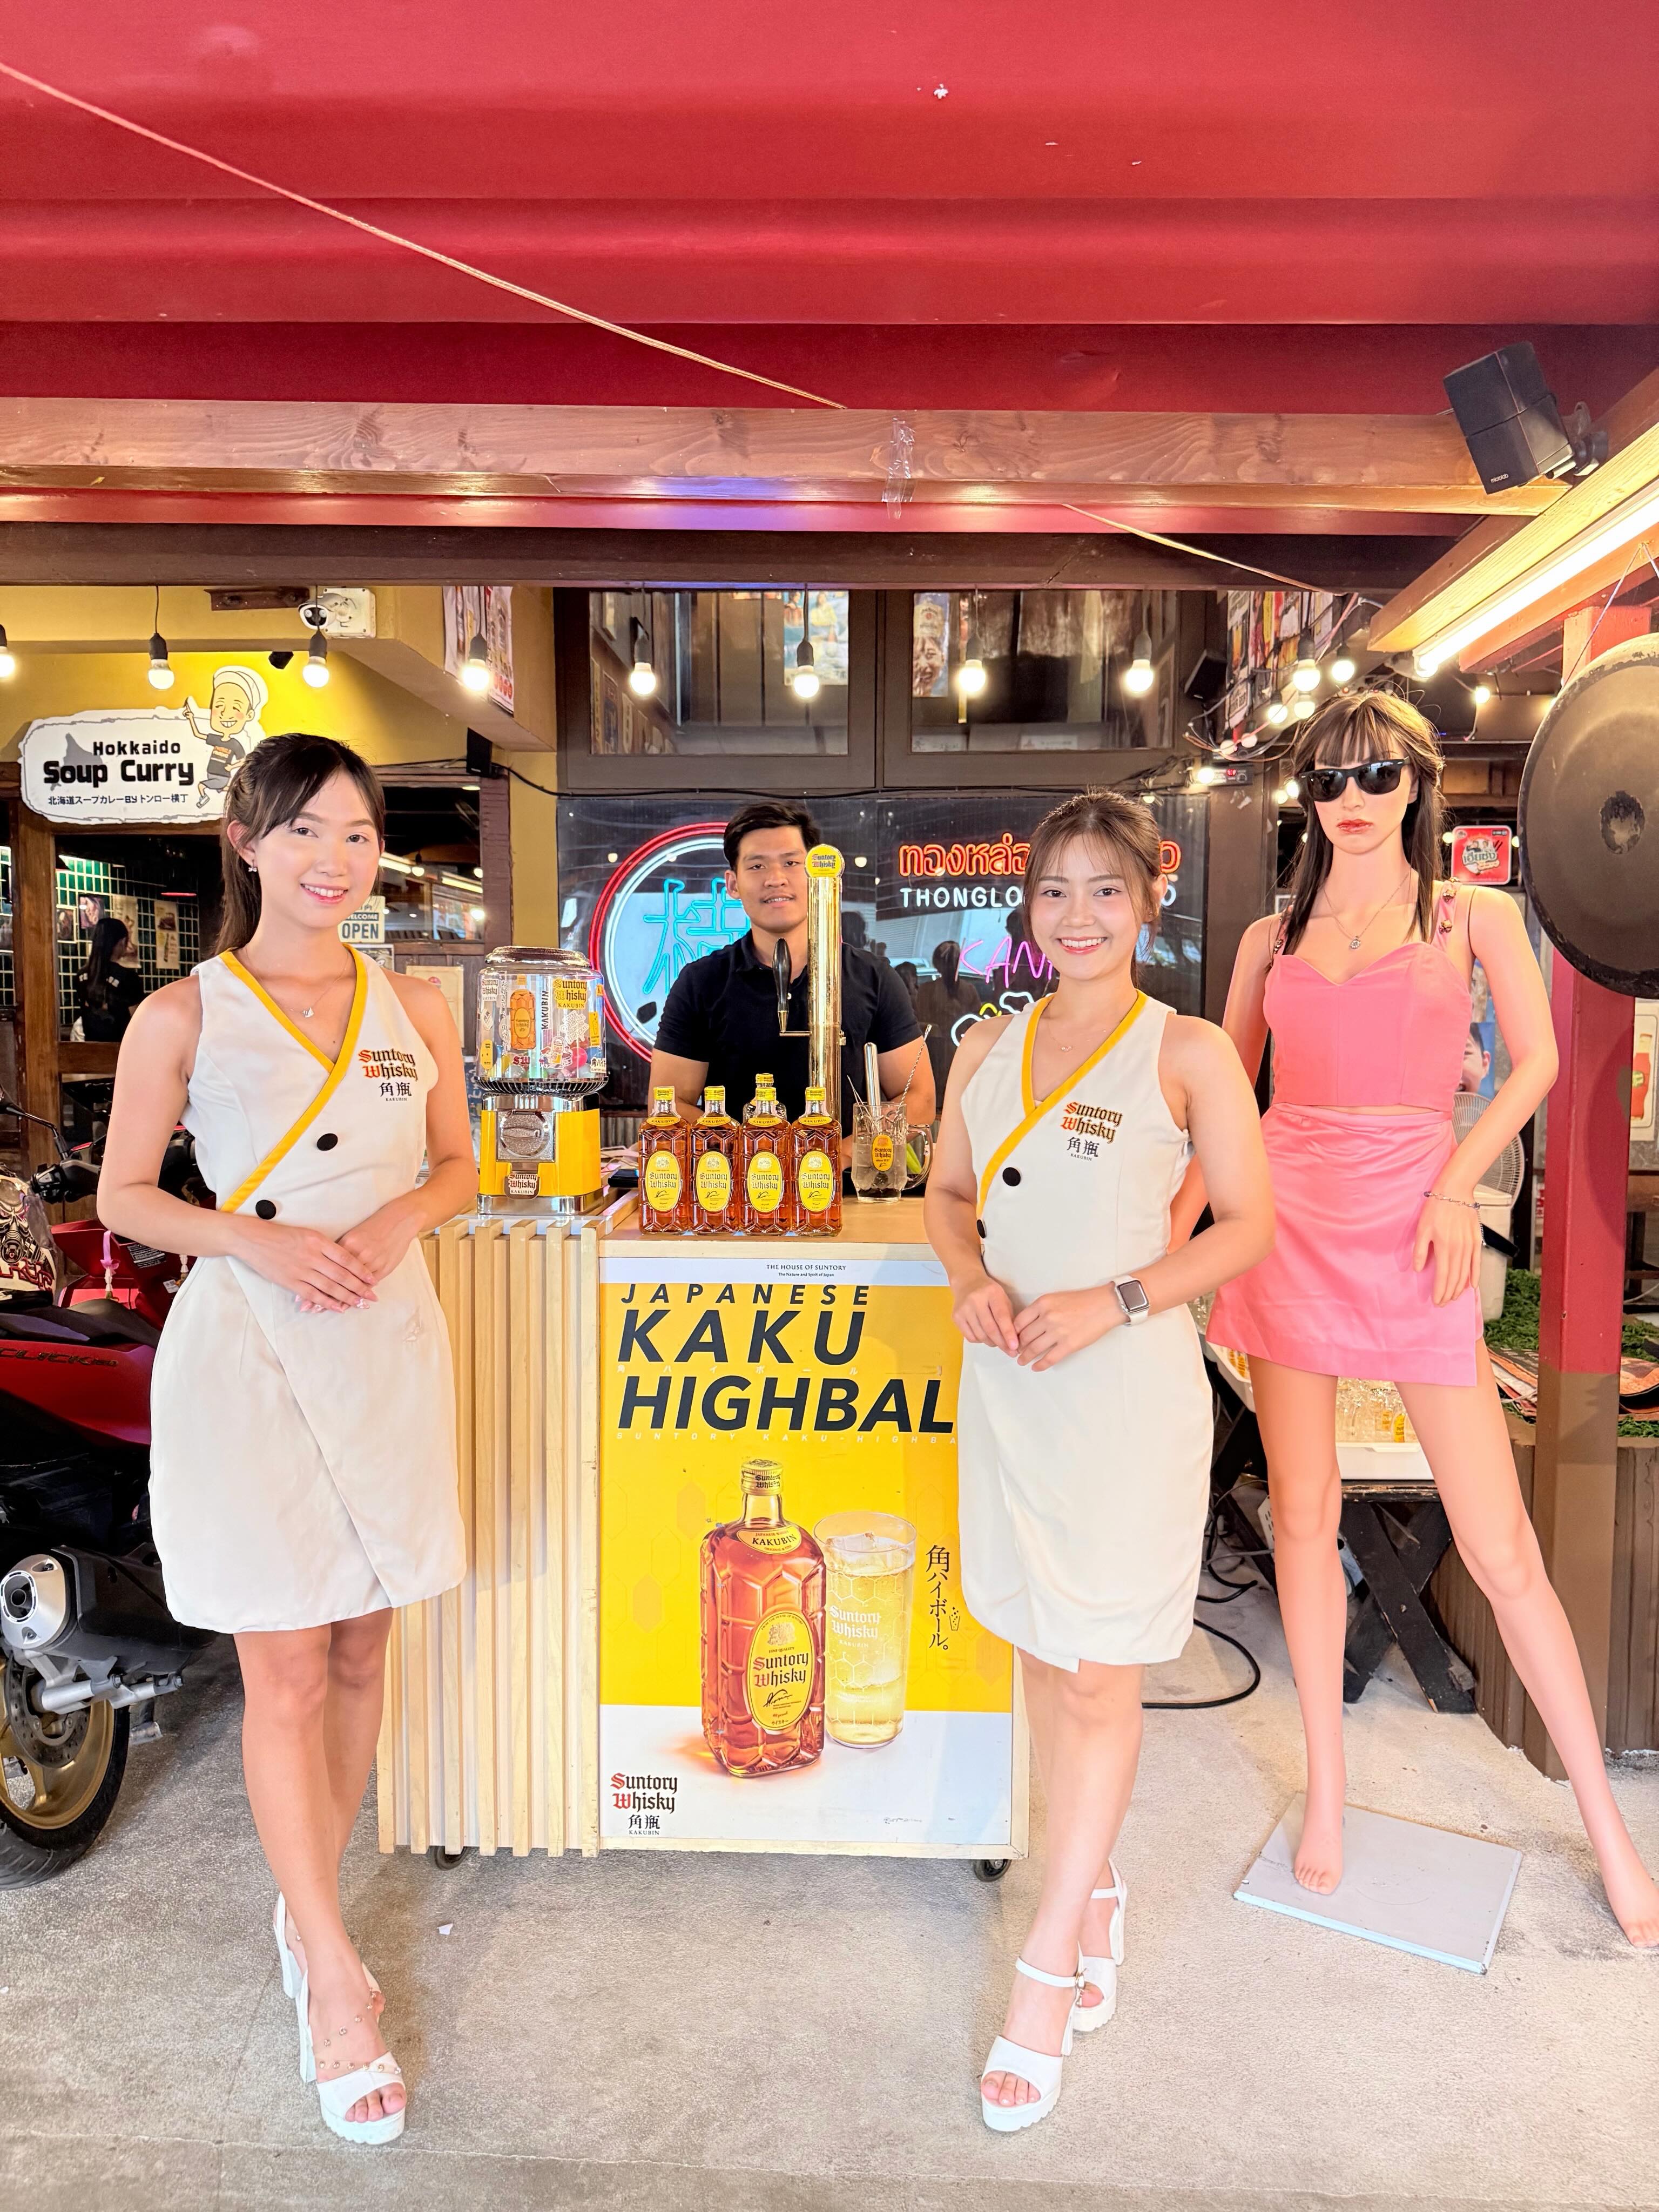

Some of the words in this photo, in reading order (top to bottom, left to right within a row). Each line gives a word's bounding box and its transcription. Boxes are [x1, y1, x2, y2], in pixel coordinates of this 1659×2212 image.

[1491, 474, 1509, 483] microlab
[93, 740, 180, 756] Hokkaido
[43, 760, 108, 787] Soup
[120, 760, 194, 786] Curry
[812, 854, 836, 862] Suntory
[900, 886, 1026, 908] THONGLO
[342, 923, 379, 939] OPEN
[955, 935, 1053, 988] KAN
[553, 978, 587, 991] Suntory
[555, 990, 586, 1002] Whisky
[358, 1048, 416, 1067] Suntory
[362, 1062, 418, 1081] Whisky
[379, 1082, 412, 1097] 角瓶
[1064, 1102, 1123, 1128] Suntory
[1061, 1117, 1116, 1144] Whisky
[1067, 1136, 1100, 1157] 角瓶
[1070, 1153, 1092, 1161] KAKUBIN
[509, 1172, 537, 1181] Suntory
[649, 1172, 677, 1181] Suntory
[700, 1172, 727, 1181] Suntory
[751, 1173, 779, 1181] Suntory
[801, 1172, 830, 1181] Suntory
[510, 1180, 536, 1189] Whisky
[650, 1180, 676, 1189] Whisky
[701, 1181, 726, 1189] Whisky
[752, 1181, 778, 1189] Whisky
[803, 1181, 829, 1189] Whisky
[621, 1284, 869, 1305] JAPANESE
[618, 1309, 865, 1365] KAKU
[617, 1433, 735, 1441] SUNTORY
[755, 1473, 781, 1481] Suntory
[756, 1481, 780, 1489] Whisky
[752, 1534, 797, 1546] KAKUBIN
[830, 1605, 881, 1624] Suntory
[831, 1620, 878, 1640] Whisky
[839, 1640, 869, 1648] KAKUBIN
[753, 1652, 808, 1671] Suntory
[754, 1668, 806, 1687] Whisky
[610, 1772, 678, 1794] Suntory
[612, 1791, 675, 1814] Whisky
[628, 1815, 660, 1829] 角瓶
